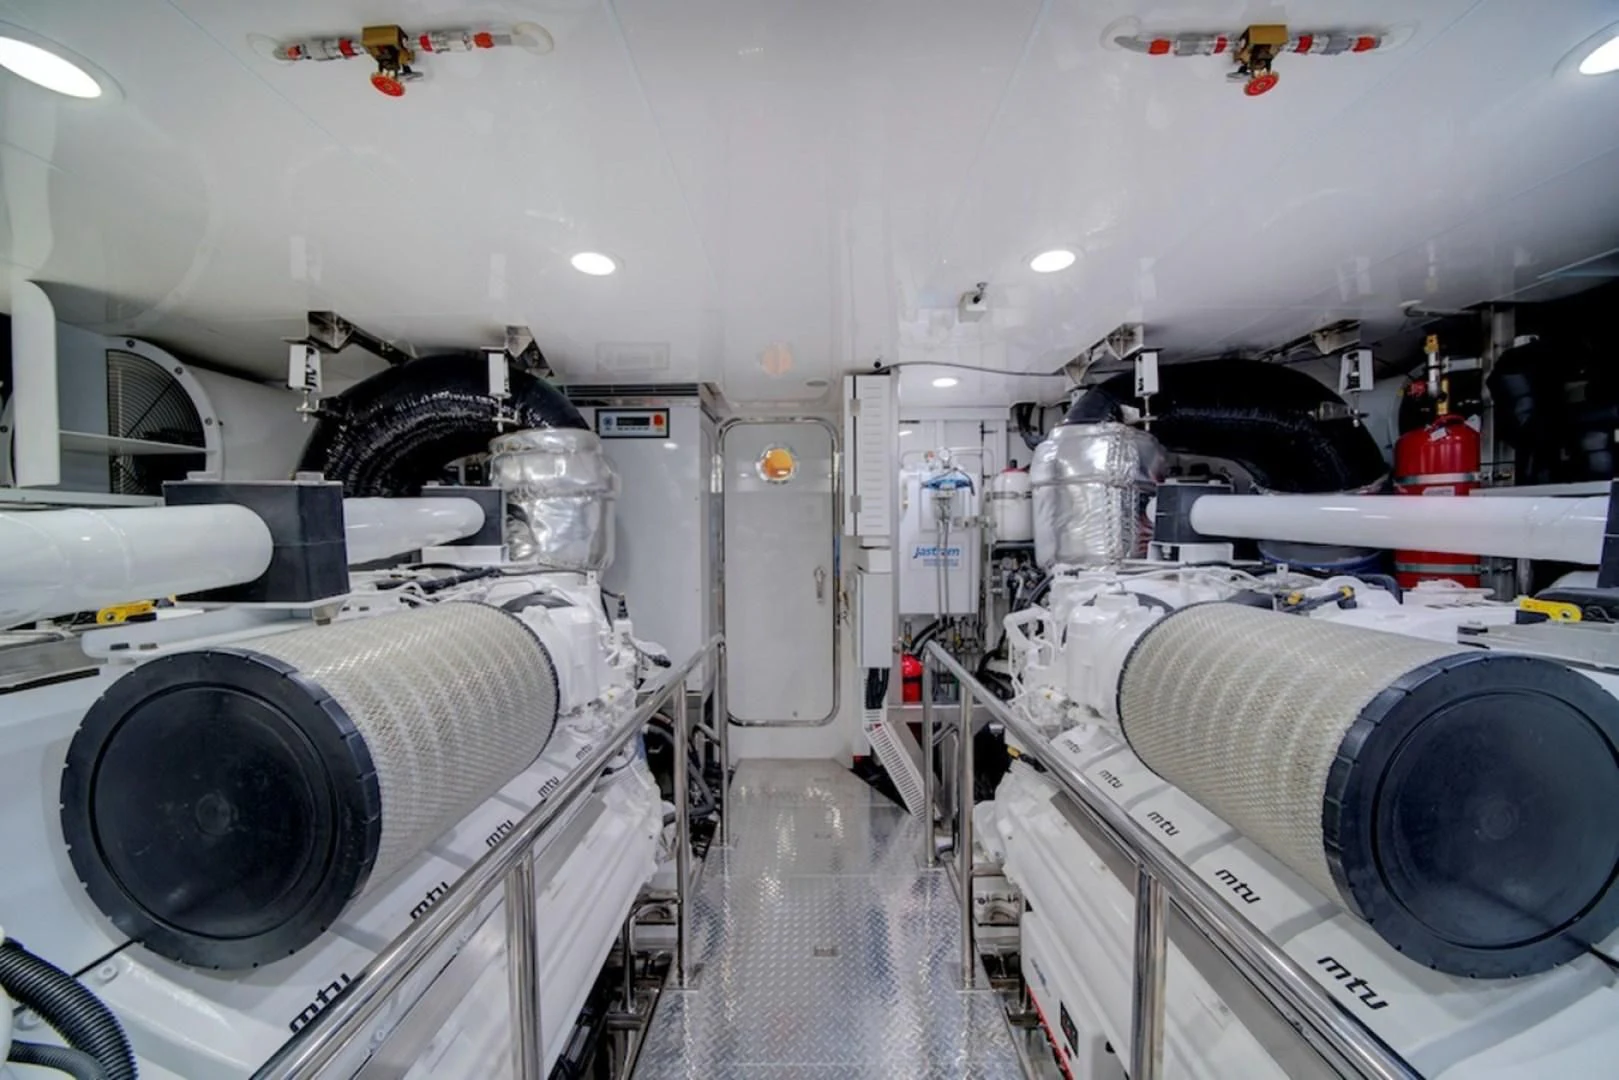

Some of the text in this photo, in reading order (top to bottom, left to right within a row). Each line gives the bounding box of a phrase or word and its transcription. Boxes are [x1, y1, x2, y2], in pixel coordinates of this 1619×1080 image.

[1061, 739, 1082, 754] mtu
[538, 776, 560, 798] mtu
[1099, 769, 1123, 788] mtu
[485, 820, 514, 847] mtu
[1147, 811, 1180, 836] mtu
[1215, 869, 1261, 904] mtu
[1317, 956, 1389, 1010] mtu
